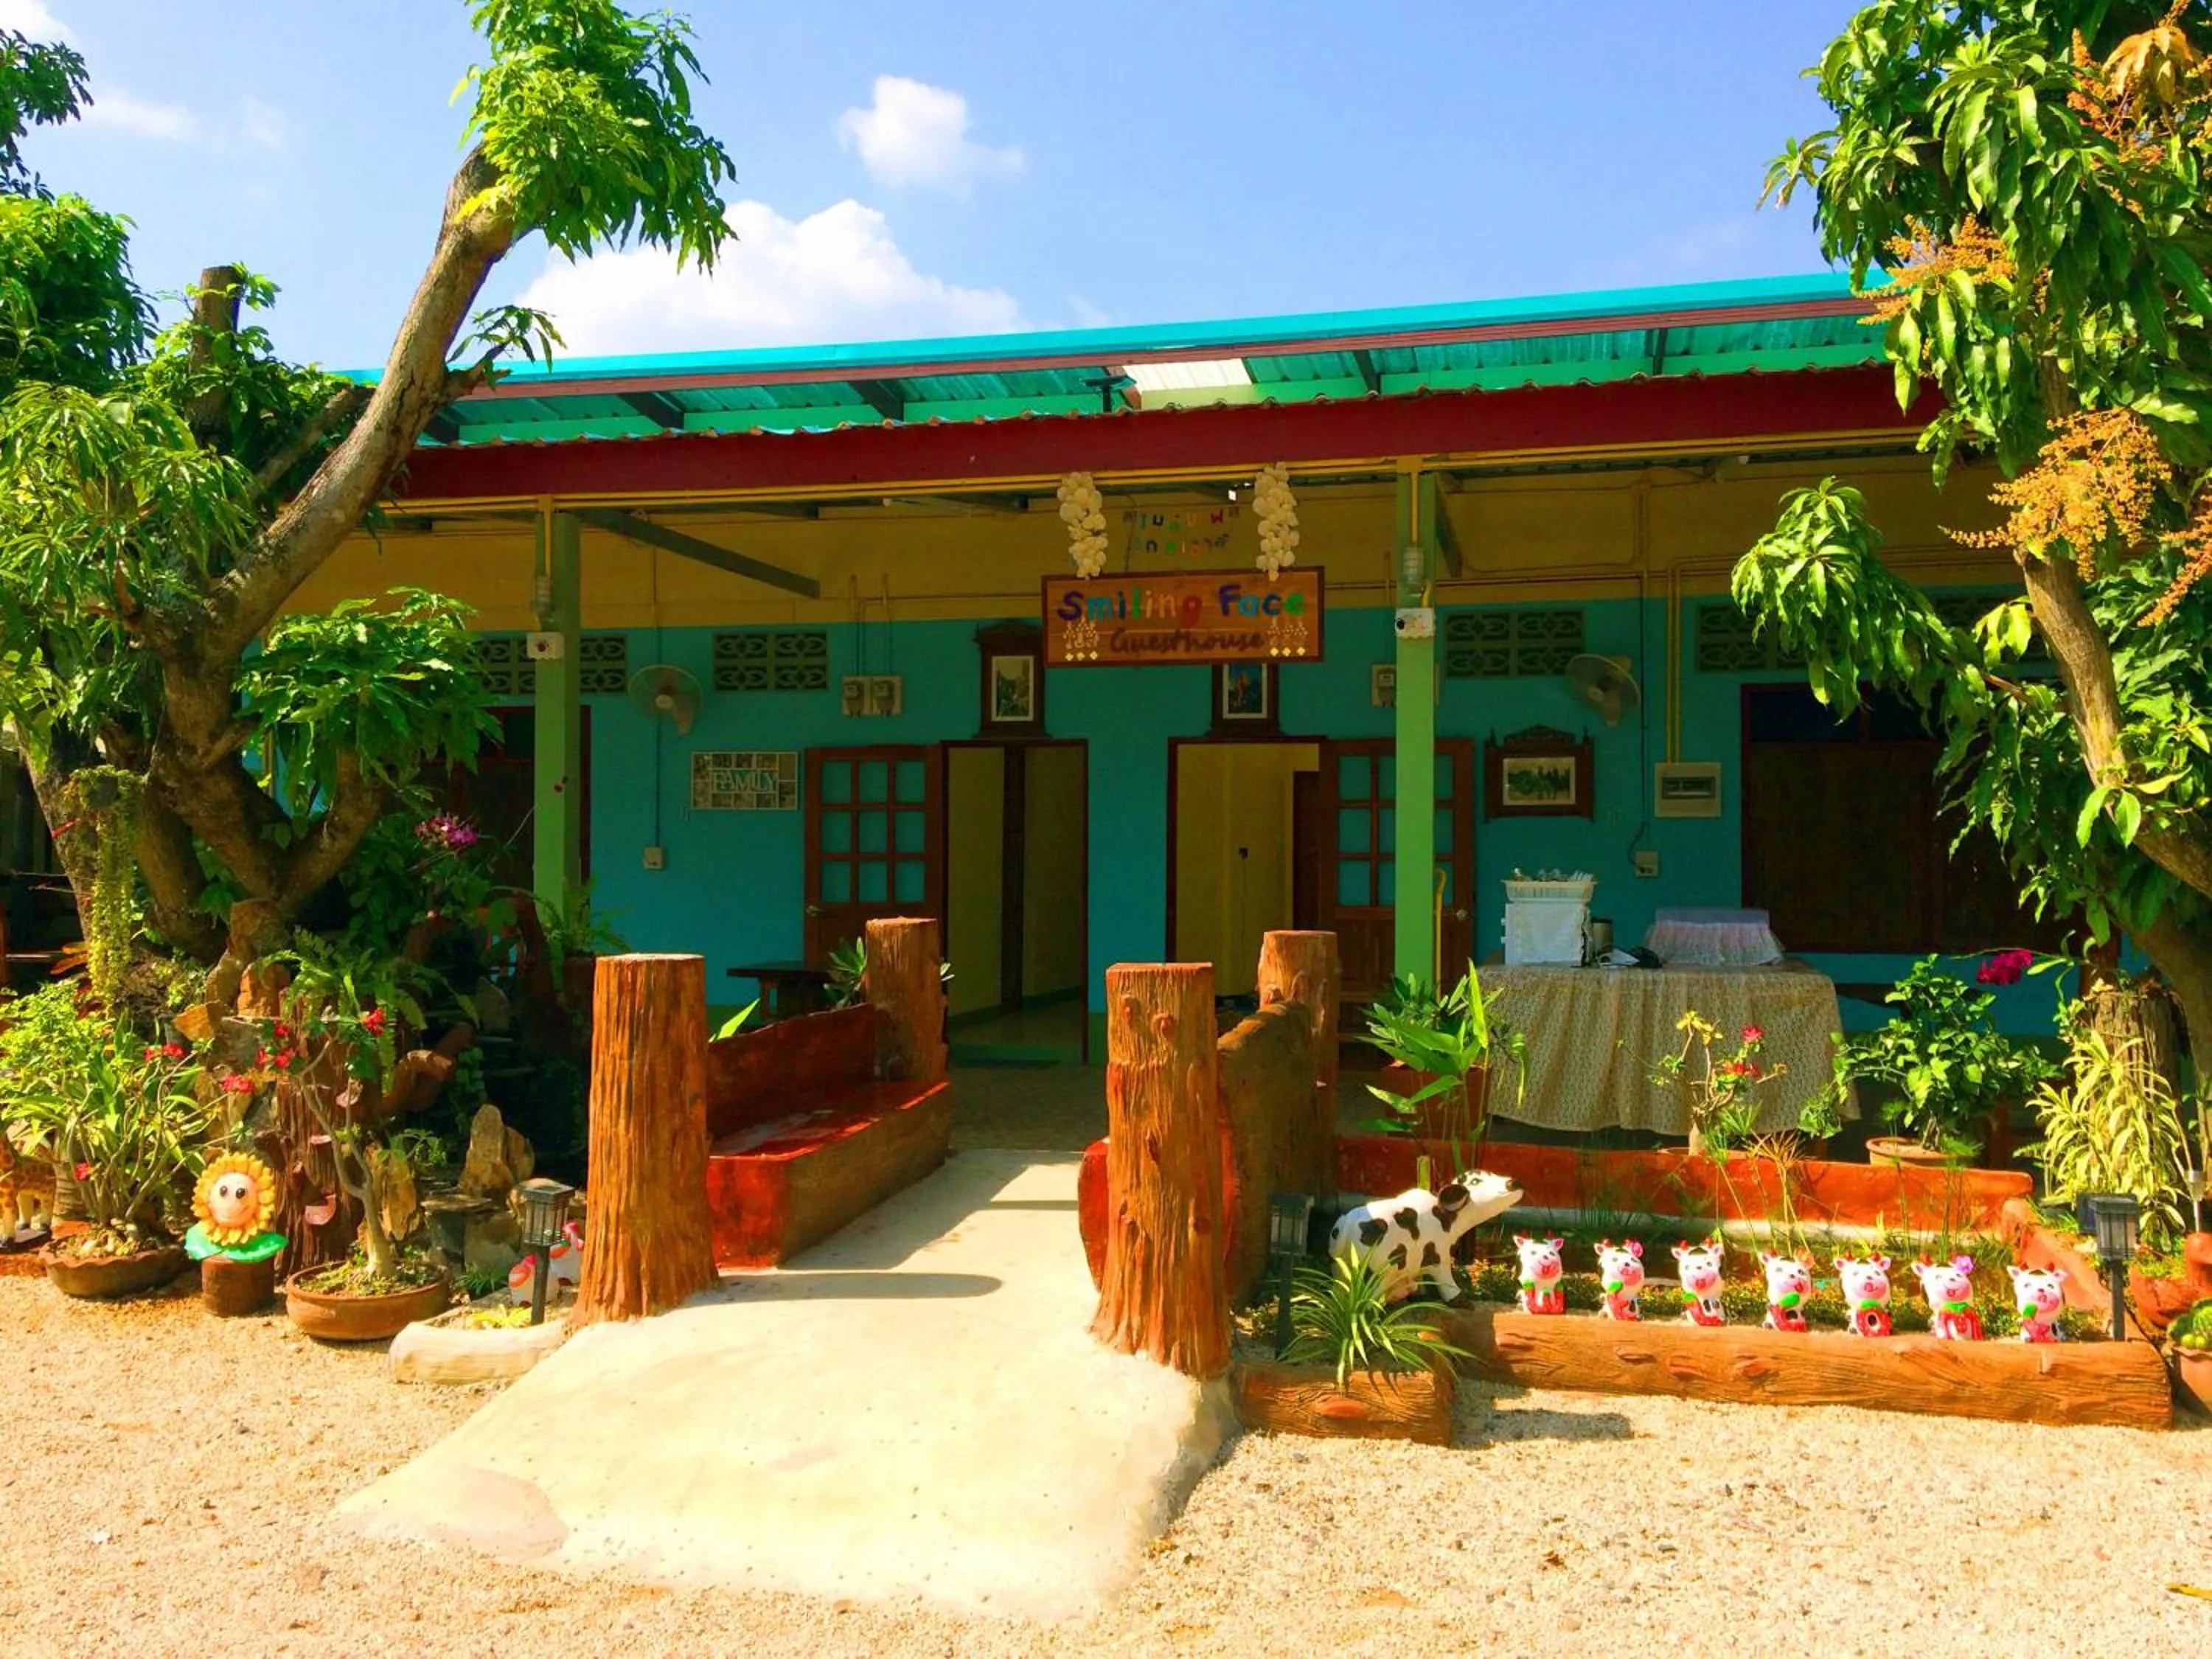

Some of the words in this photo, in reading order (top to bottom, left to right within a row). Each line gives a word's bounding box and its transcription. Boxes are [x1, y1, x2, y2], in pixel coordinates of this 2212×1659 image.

[1057, 588, 1201, 627] Smiling
[1218, 583, 1306, 617] Face
[1110, 627, 1265, 654] Guesthouse
[713, 770, 777, 793] FAMILY
